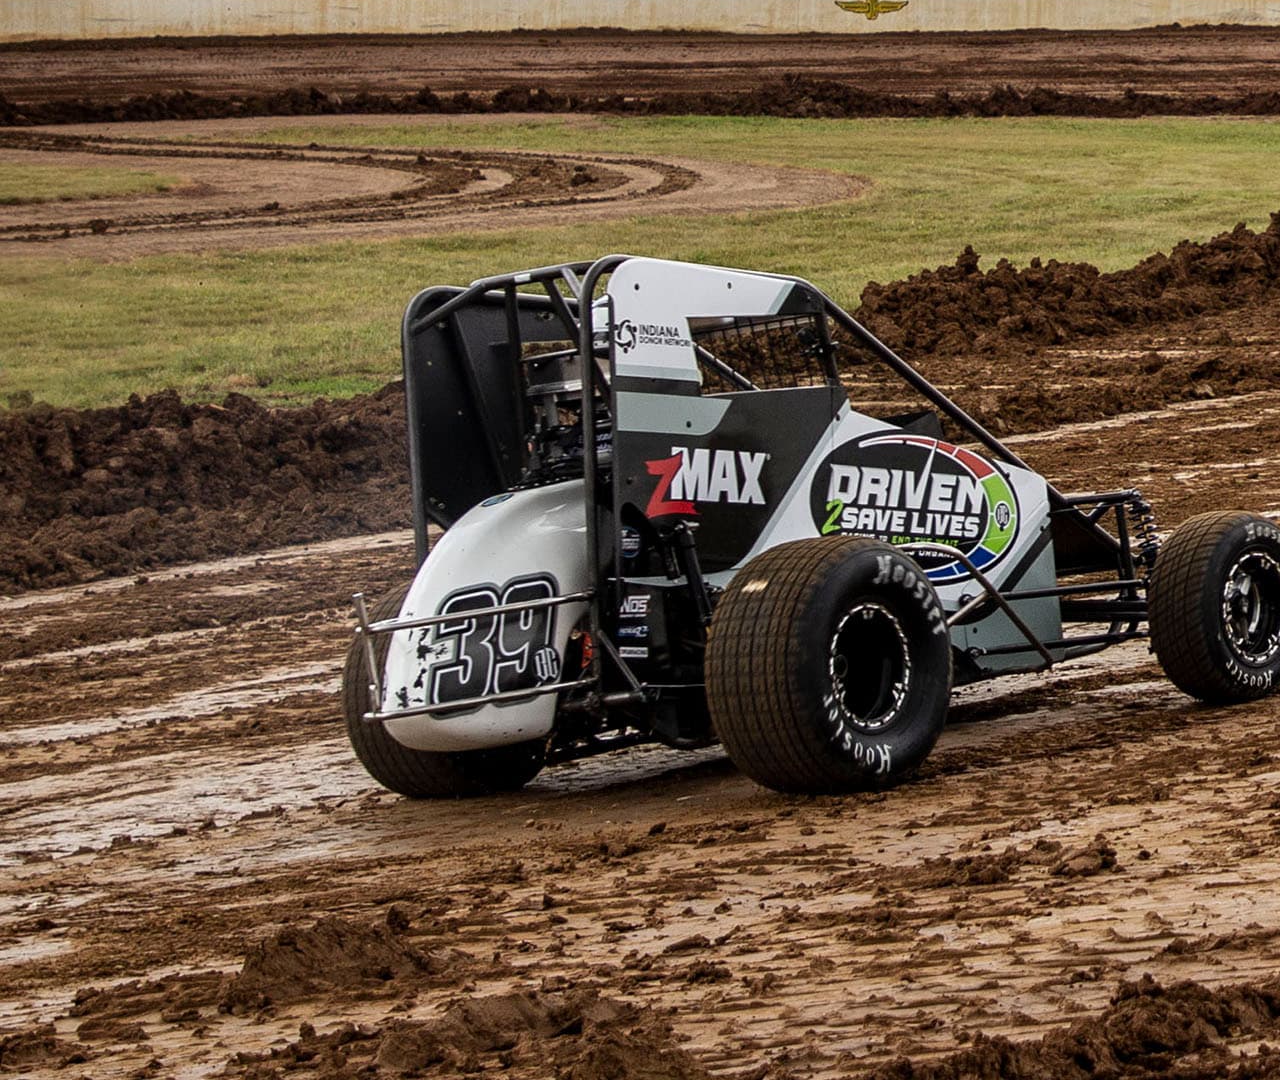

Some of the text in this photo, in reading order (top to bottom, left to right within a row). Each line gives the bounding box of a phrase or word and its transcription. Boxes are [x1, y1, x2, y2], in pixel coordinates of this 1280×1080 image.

[639, 324, 680, 337] INDIANA
[827, 463, 986, 515] DRIVEN
[821, 499, 981, 538] 2 SAVE LIVES
[891, 535, 911, 545] END
[428, 574, 557, 716] 39
